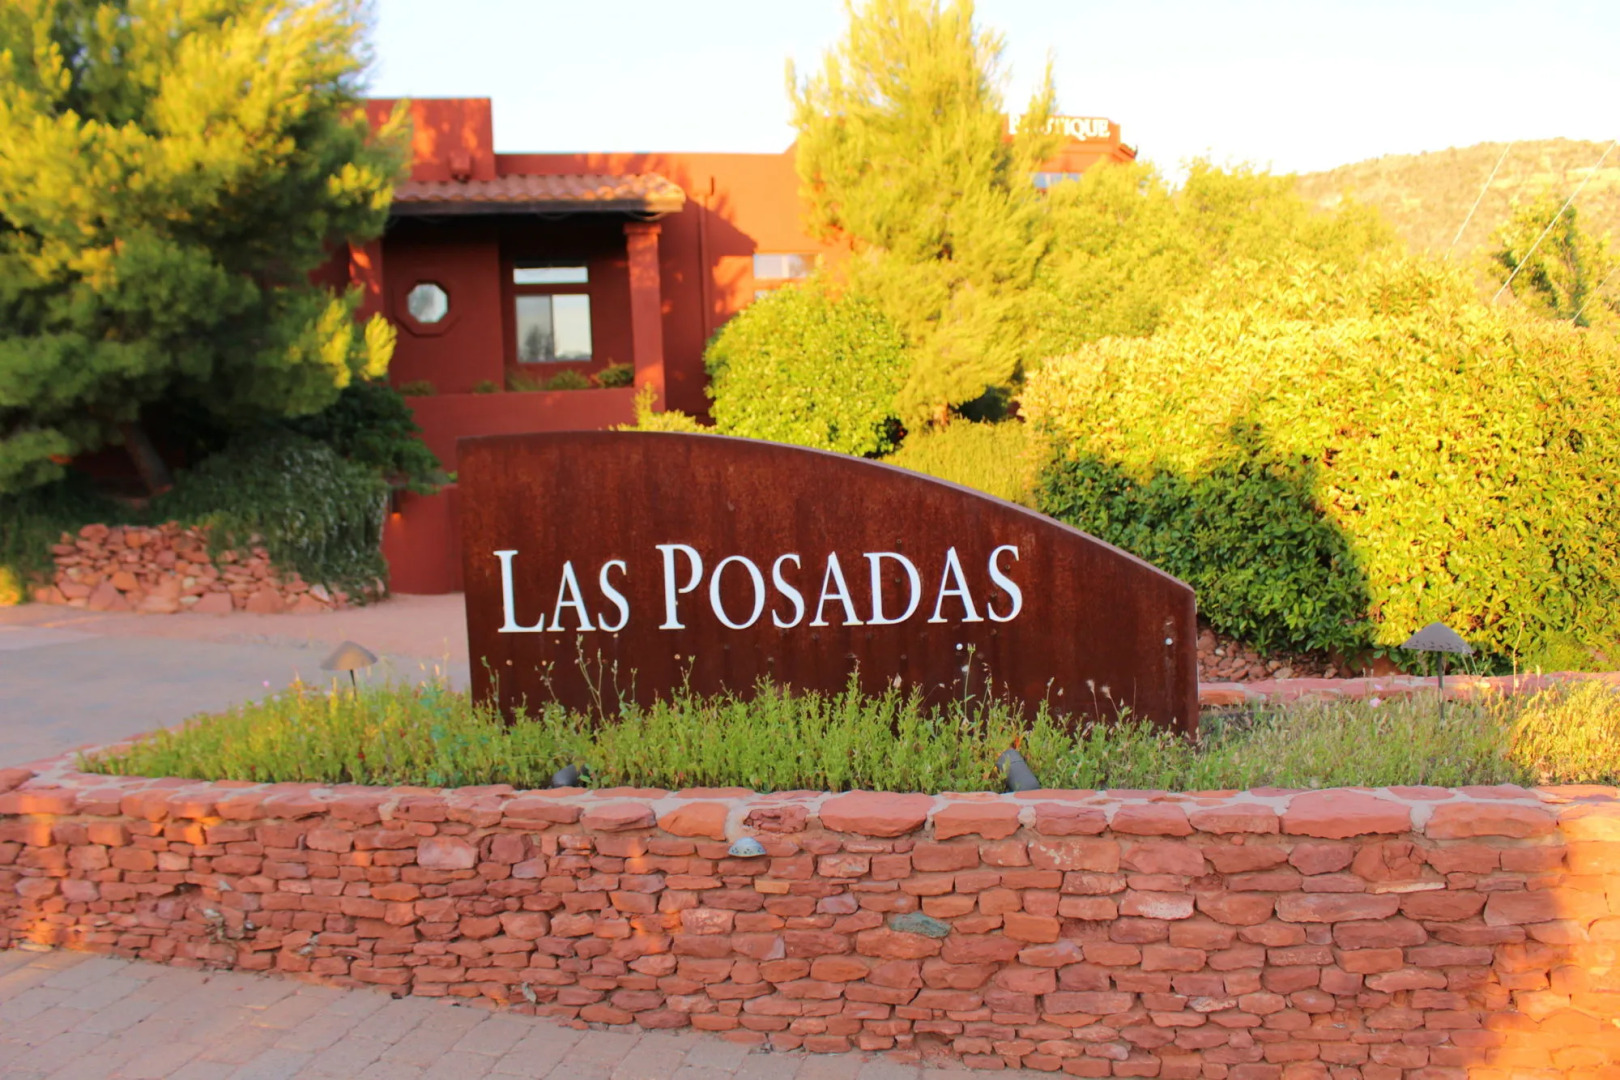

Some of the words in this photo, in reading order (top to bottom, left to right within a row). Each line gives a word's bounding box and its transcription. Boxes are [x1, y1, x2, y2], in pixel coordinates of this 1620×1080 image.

[1008, 114, 1111, 141] BTIQUE
[493, 549, 630, 633] LAS
[655, 543, 1023, 630] POSADAS
